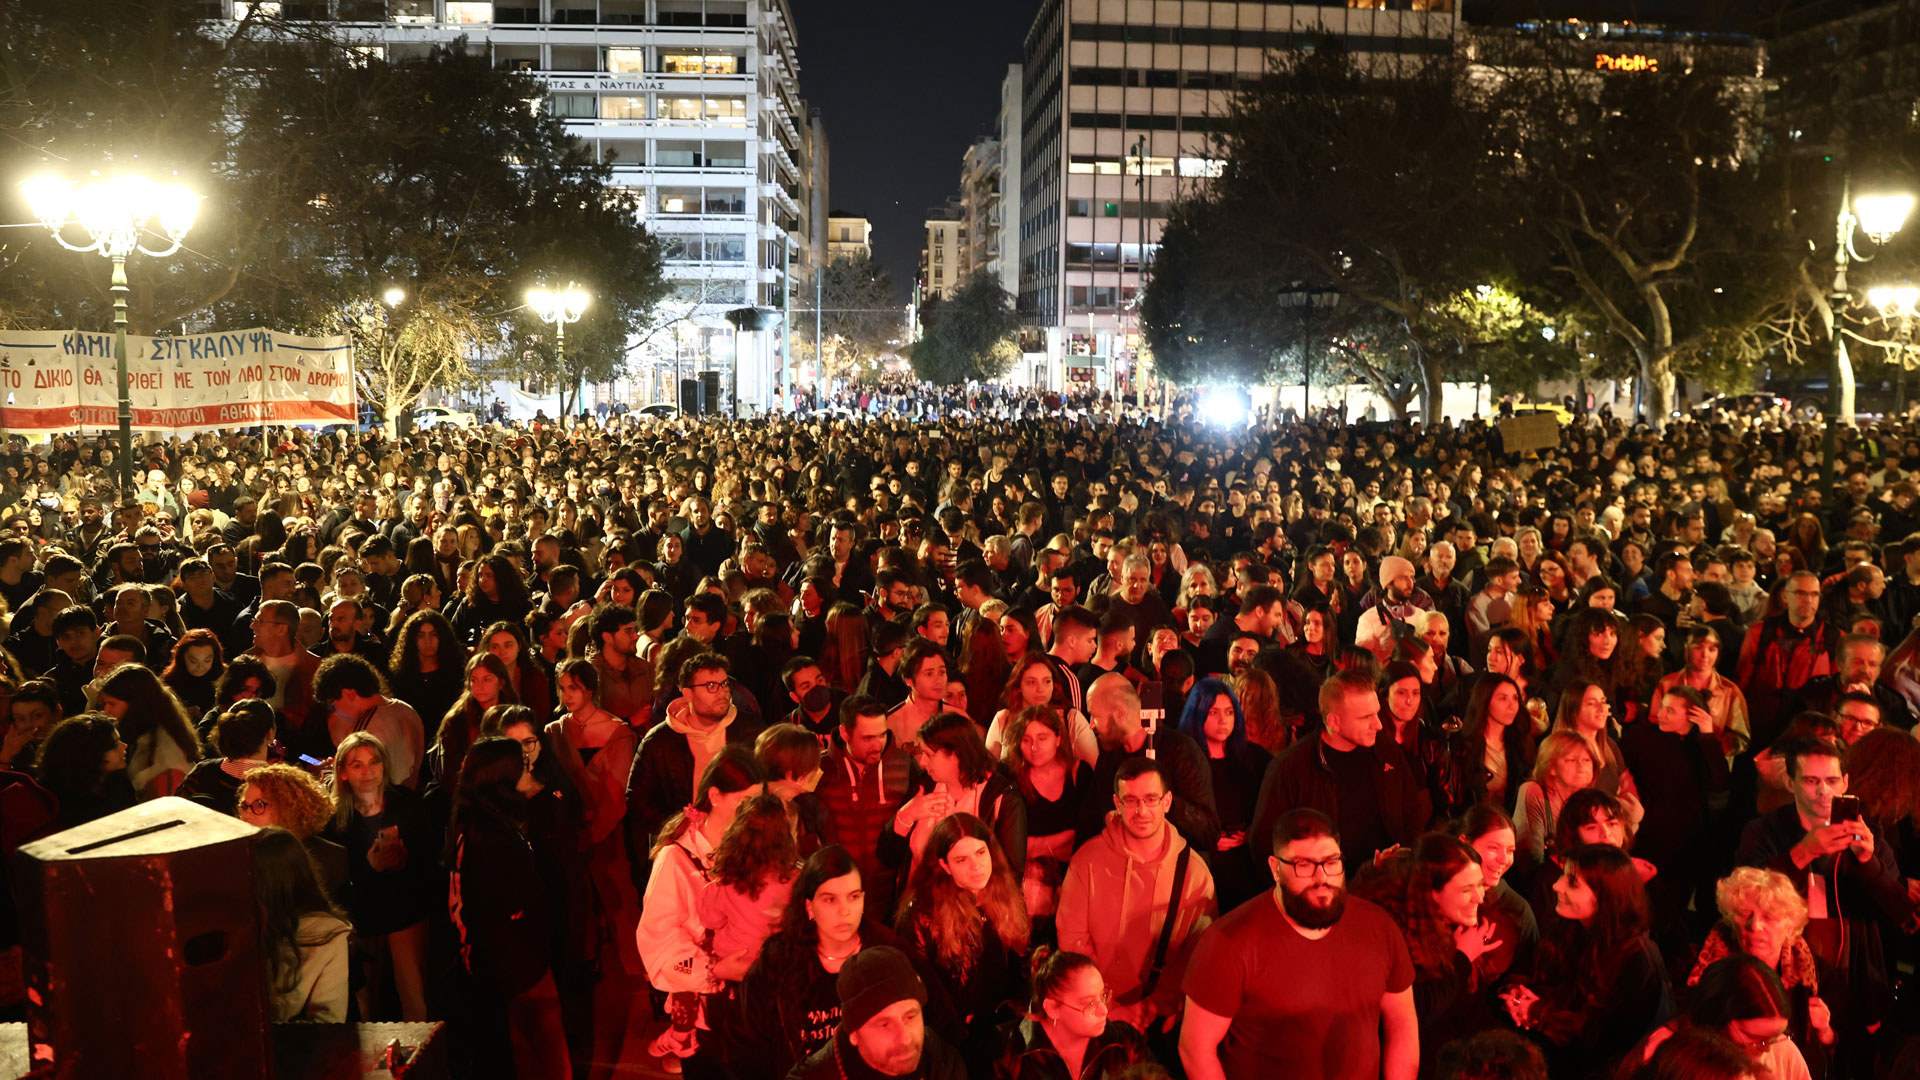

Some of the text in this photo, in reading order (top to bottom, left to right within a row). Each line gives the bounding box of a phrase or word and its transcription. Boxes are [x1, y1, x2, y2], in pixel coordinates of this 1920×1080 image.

[1596, 54, 1658, 72] Public
[583, 81, 592, 89] &
[600, 81, 665, 90] ΝΑΥΤΙΛΙΑΣ
[62, 331, 273, 360] ΚΑΜΙ ΣΥΓΚΑΛΥΨΗ
[1, 365, 349, 390] ΤΟ ΔΙΚΙΟ ΘΑ ΡΙΘΕΙ ΜΕ ΤΟΝ ΛΑΟ ΣΤΟΝ ΔΡΟΜΟ!
[220, 402, 274, 420] ΑΘΗΝΑΣ
